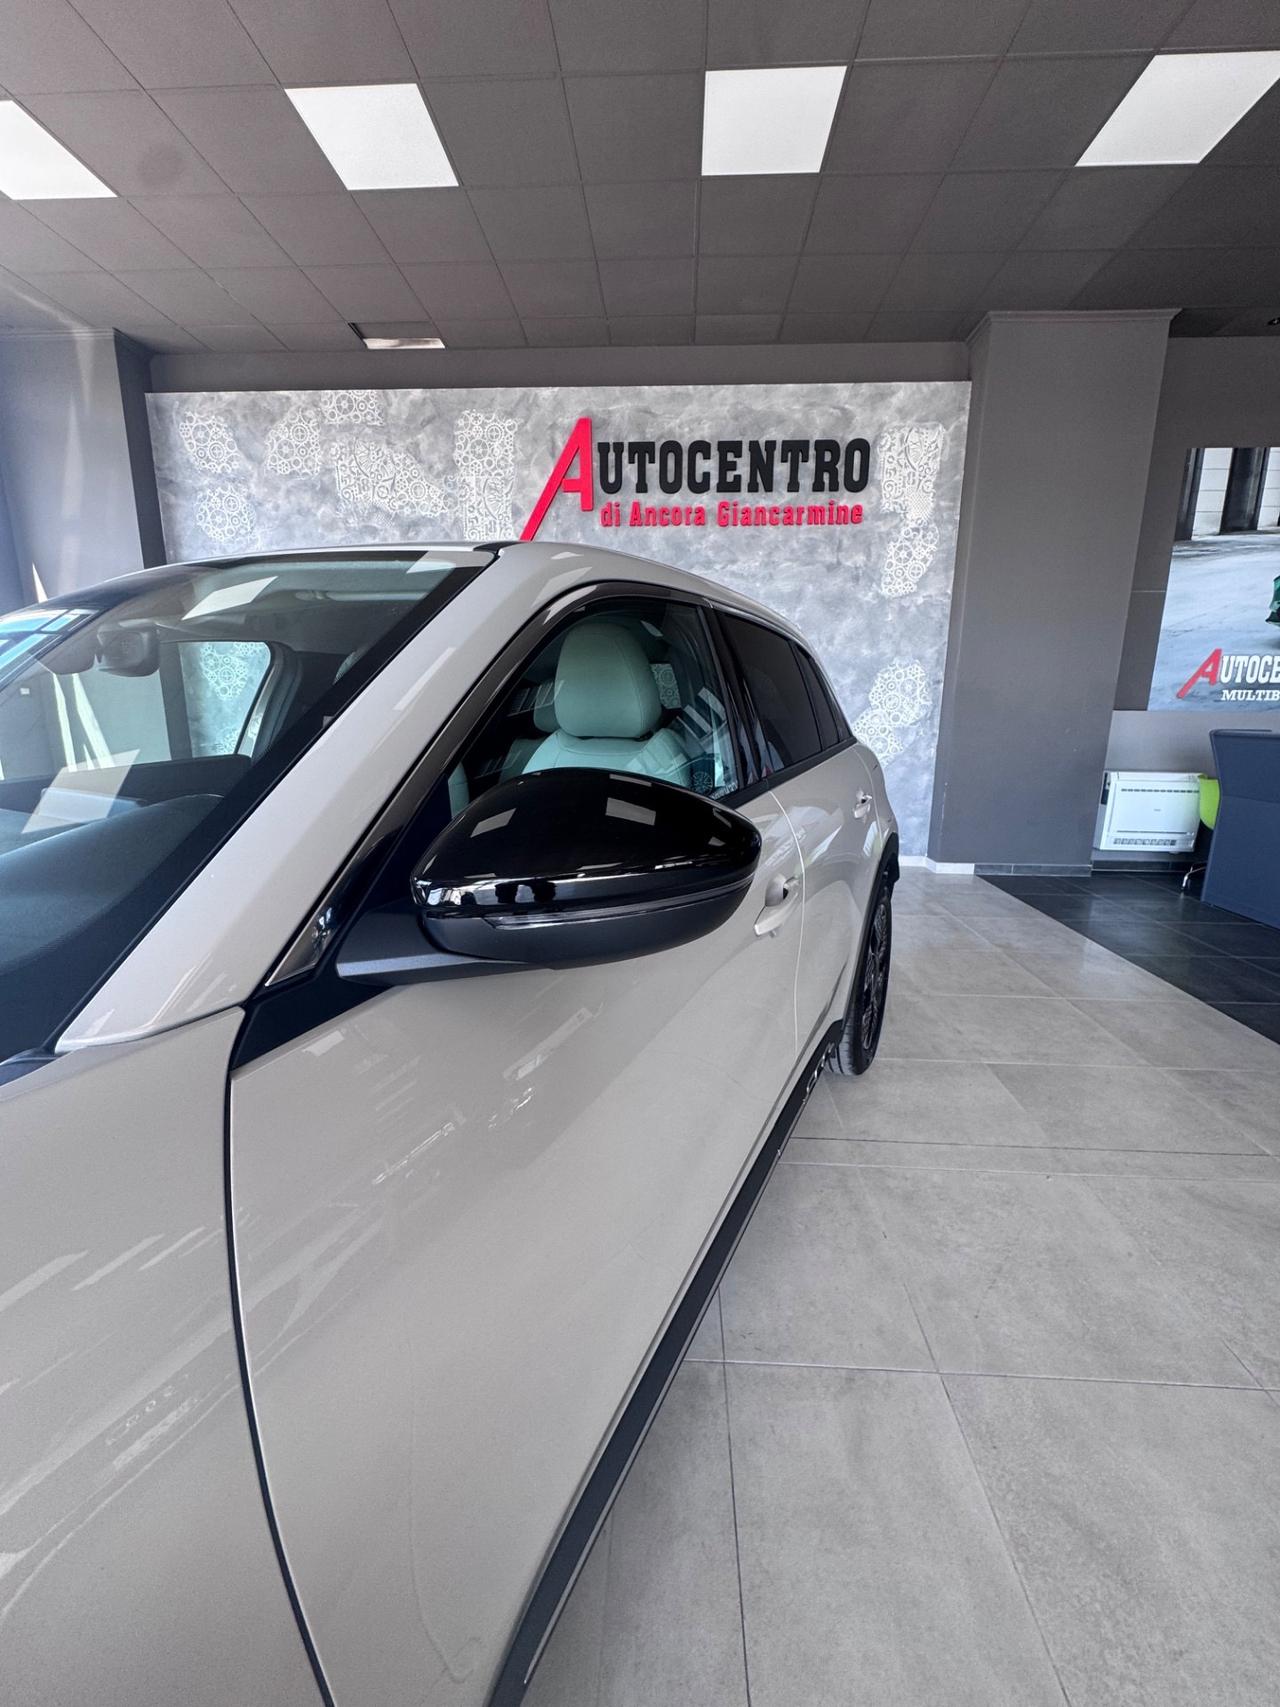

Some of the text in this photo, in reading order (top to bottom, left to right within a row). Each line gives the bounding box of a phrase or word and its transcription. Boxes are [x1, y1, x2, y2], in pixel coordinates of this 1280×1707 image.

[520, 417, 871, 541] AUTOCENTRO
[600, 500, 863, 527] di Ancora Giancarmine
[1221, 689, 1280, 701] MULTIB
